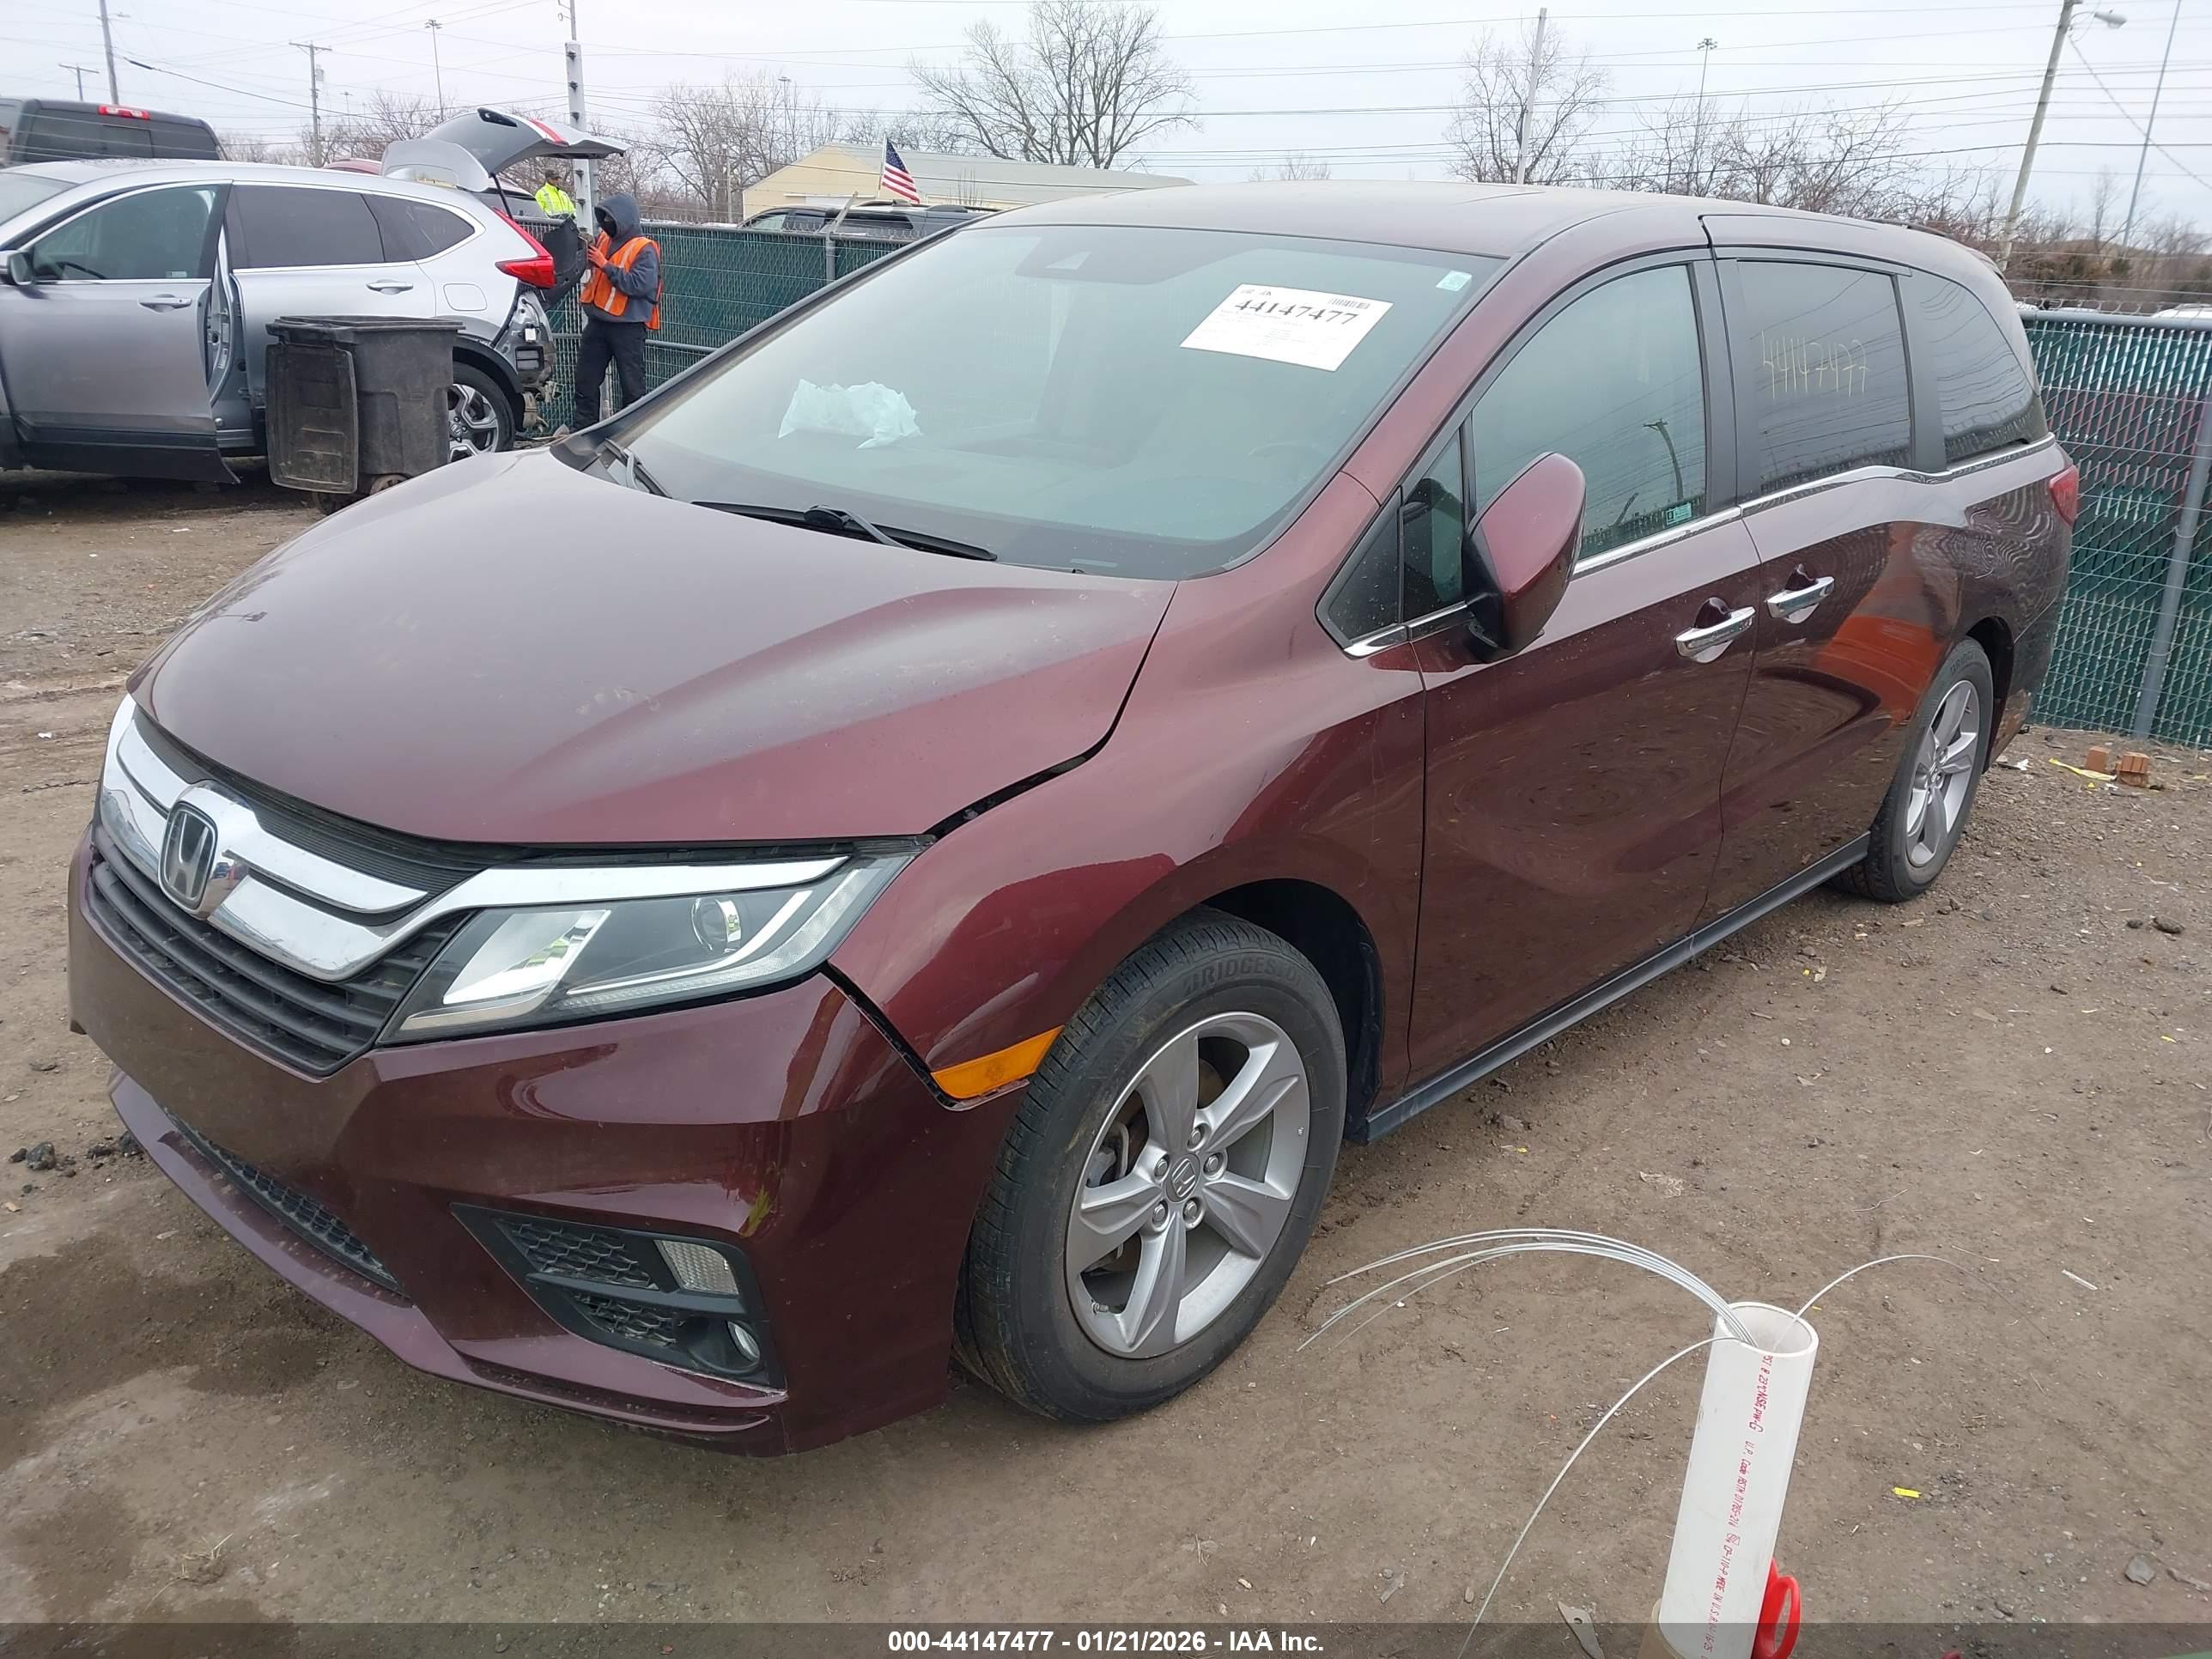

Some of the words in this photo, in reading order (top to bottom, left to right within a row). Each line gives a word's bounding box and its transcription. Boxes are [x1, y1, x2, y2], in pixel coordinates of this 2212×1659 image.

[1234, 299, 1360, 325] 44147477
[1762, 330, 1871, 399] 44147477
[1182, 955, 1309, 994] BRIDGESTO
